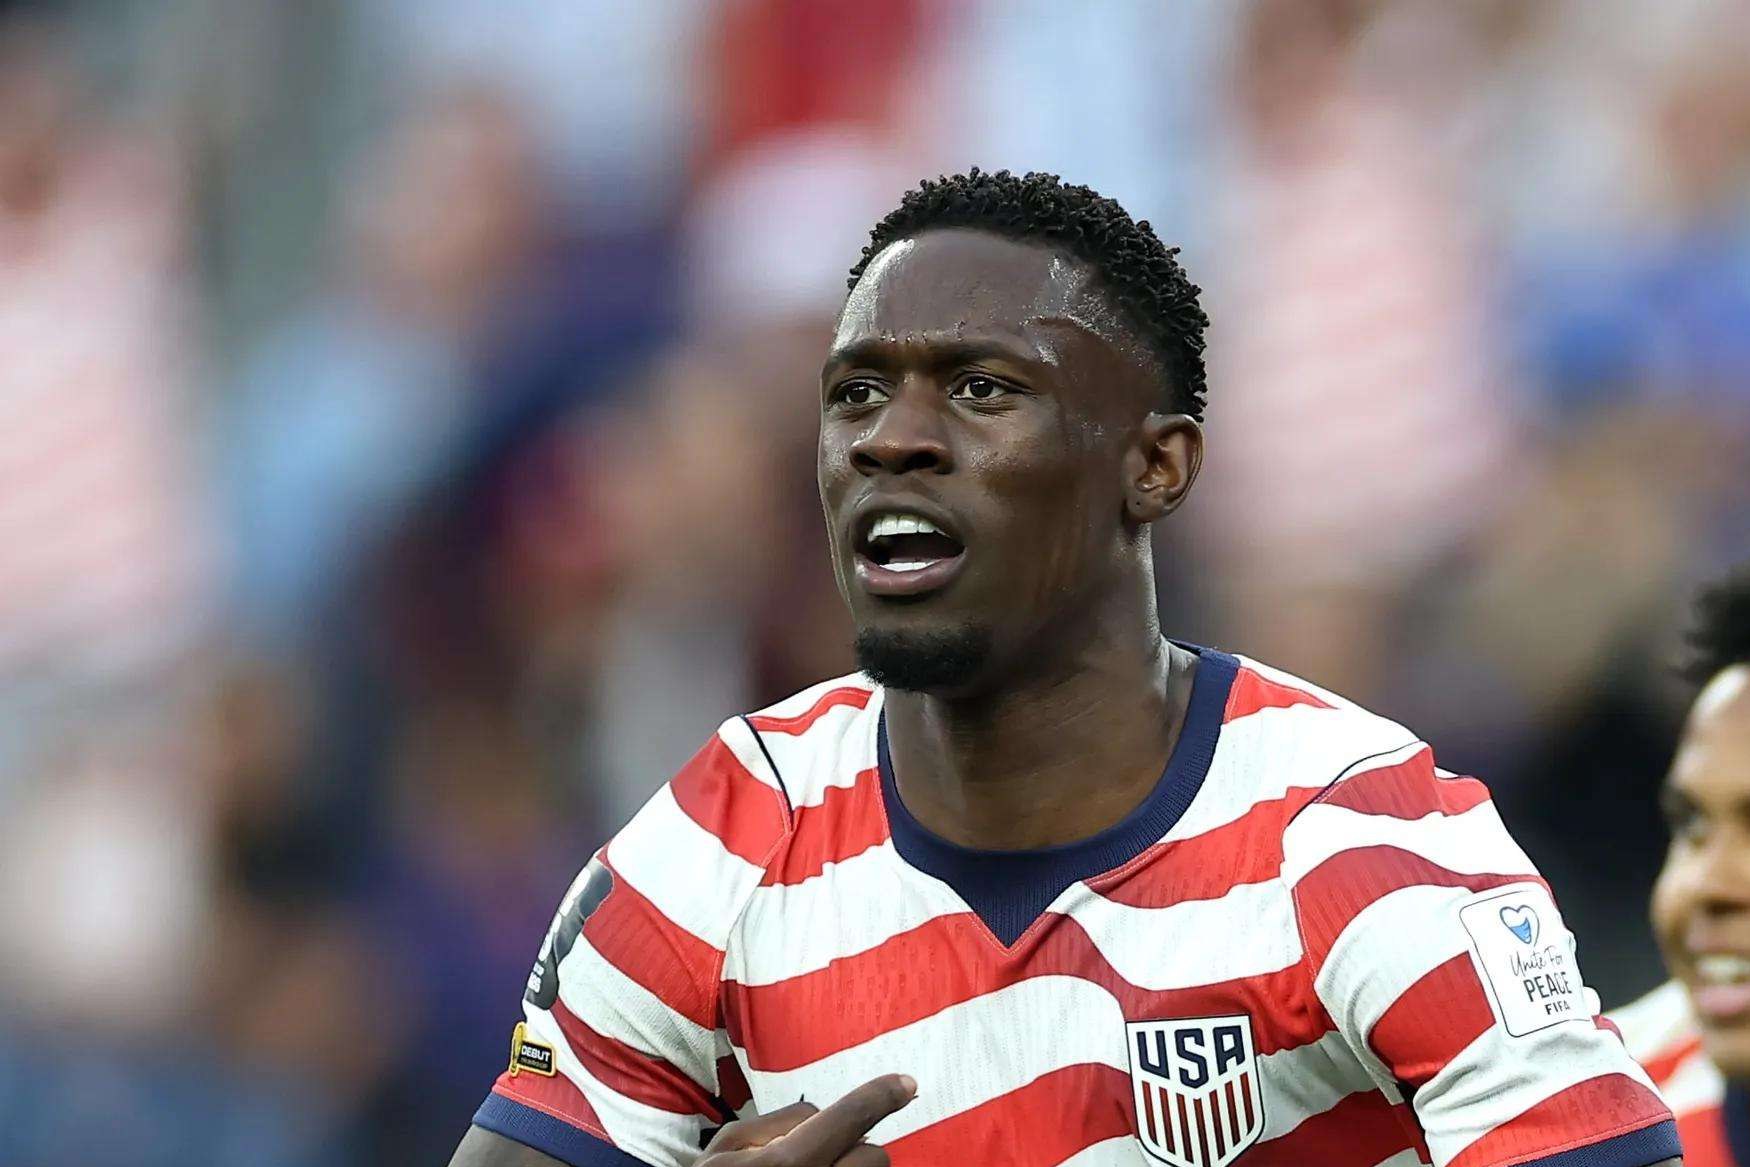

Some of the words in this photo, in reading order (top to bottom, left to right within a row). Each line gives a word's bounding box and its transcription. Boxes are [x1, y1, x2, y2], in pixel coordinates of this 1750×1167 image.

[1509, 950, 1547, 977] Unite
[1523, 971, 1573, 1002] PEACE
[1545, 1000, 1571, 1015] FIFA
[521, 1045, 551, 1062] DEBUT
[1136, 1025, 1246, 1089] USA
